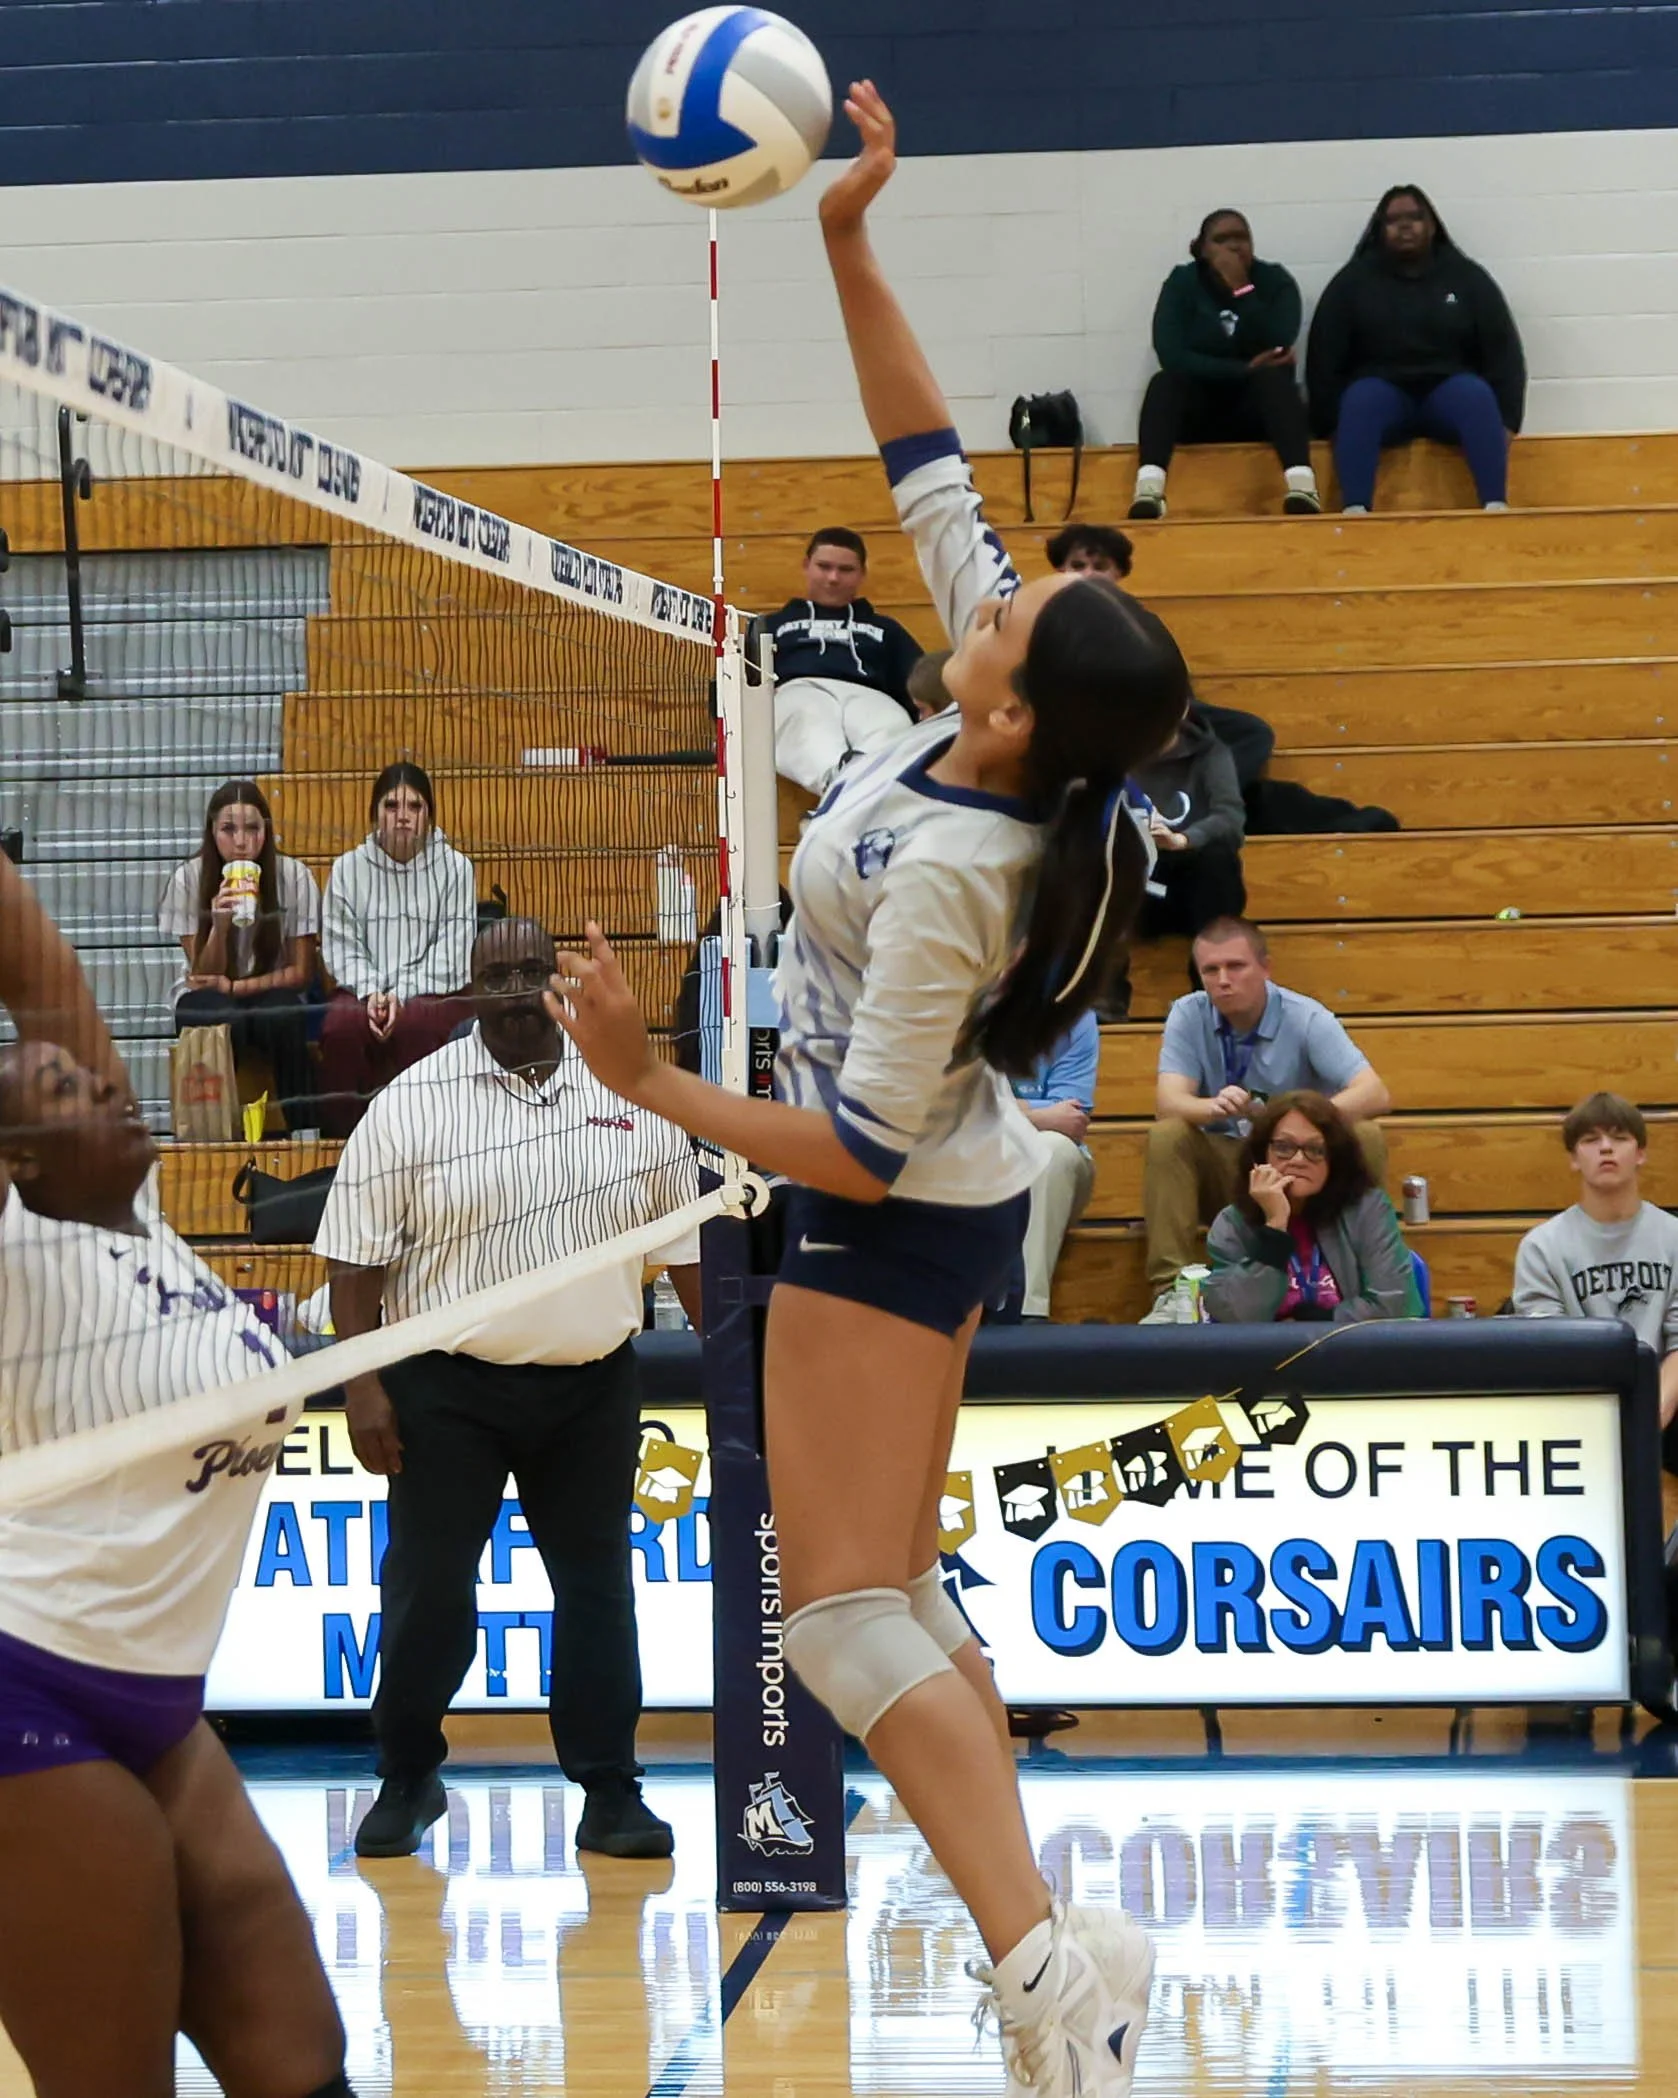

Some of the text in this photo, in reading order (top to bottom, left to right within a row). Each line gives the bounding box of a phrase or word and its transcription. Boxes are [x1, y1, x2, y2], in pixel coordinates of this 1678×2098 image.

[1305, 1441, 1405, 1498] OF
[1432, 1440, 1585, 1496] THE
[1030, 1535, 1609, 1657] CORSAIRS
[756, 1621, 789, 1747] imports
[733, 1881, 817, 1893] (800) 556-3198
